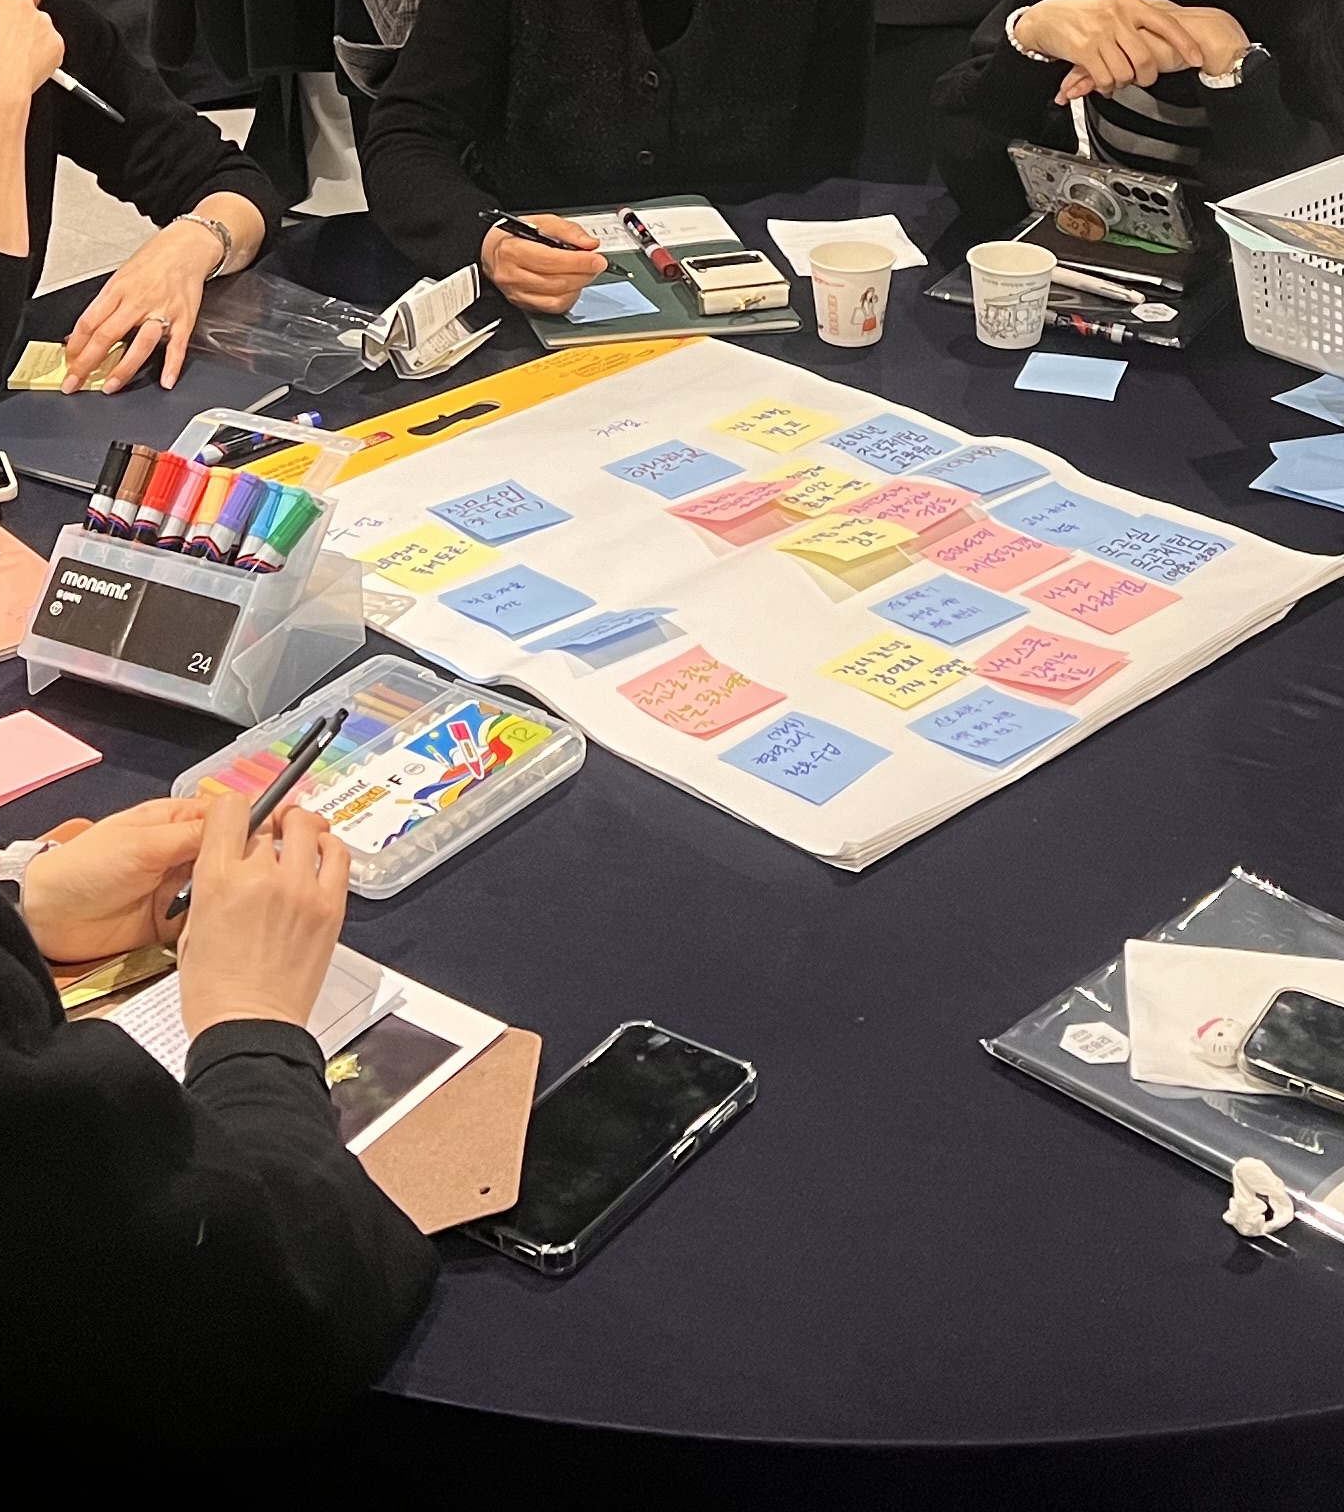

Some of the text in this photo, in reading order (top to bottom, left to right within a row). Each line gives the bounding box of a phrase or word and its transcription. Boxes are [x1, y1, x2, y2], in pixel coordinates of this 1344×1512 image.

[857, 429, 928, 459] 진로체험
[444, 485, 525, 518] 질문수업
[1097, 528, 1160, 558] 목공실
[1131, 533, 1209, 571] 목공체험
[187, 652, 213, 675] 24
[507, 726, 537, 743] 12
